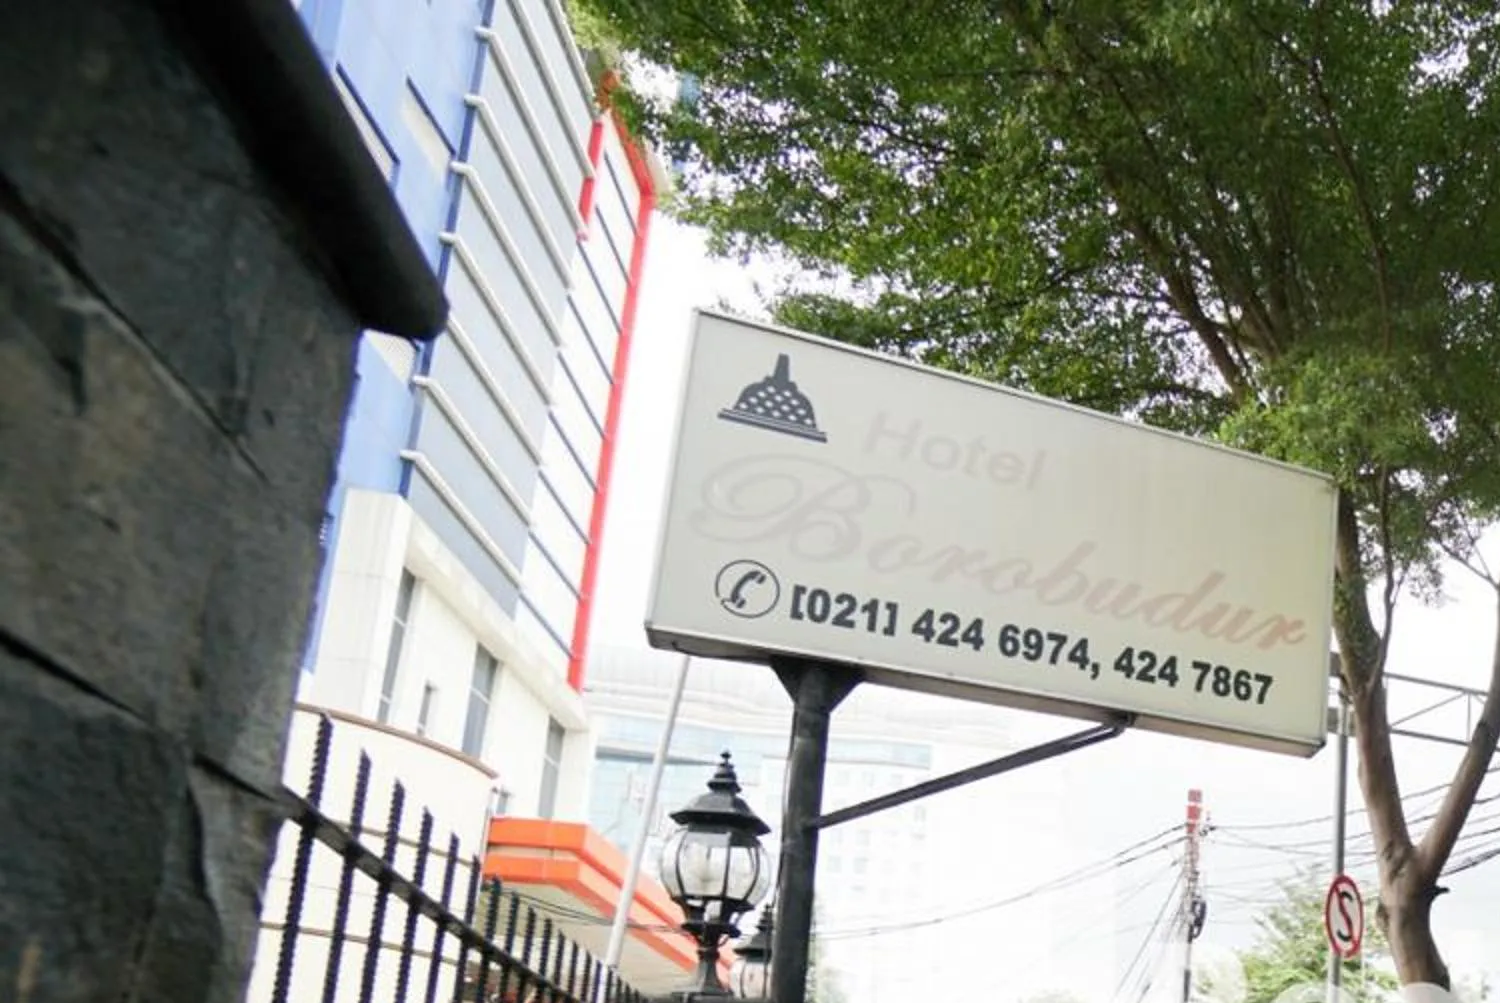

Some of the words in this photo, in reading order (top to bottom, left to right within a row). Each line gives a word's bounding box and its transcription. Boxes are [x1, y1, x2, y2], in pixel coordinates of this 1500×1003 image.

[862, 410, 1047, 491] Hotel
[688, 452, 1309, 652] Borobudur
[911, 608, 984, 651] 424
[998, 624, 1100, 680] 6974,
[1113, 646, 1179, 688] 424
[1191, 660, 1274, 704] 7867
